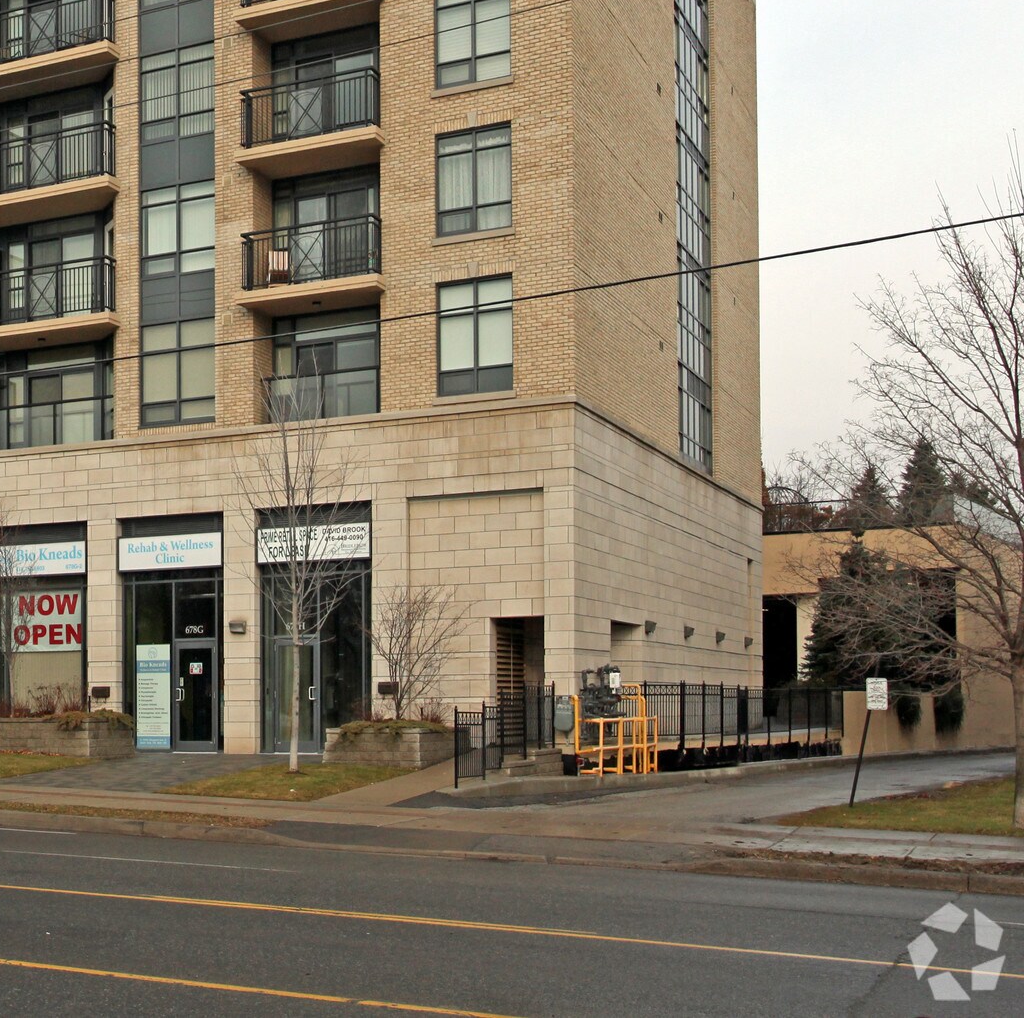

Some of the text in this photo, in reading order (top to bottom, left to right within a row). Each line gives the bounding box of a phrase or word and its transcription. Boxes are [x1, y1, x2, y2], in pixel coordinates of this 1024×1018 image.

[260, 530, 277, 542] PRIME
[299, 527, 317, 542] SPCE
[342, 525, 366, 533] BROOK
[127, 538, 214, 553] Rehab & Wellness
[268, 545, 284, 558] FOR
[16, 545, 83, 562] Bio Kneads
[155, 552, 185, 564] Clinic
[18, 593, 78, 617] NOW
[13, 623, 82, 646] OPEN
[184, 625, 204, 634] 678G
